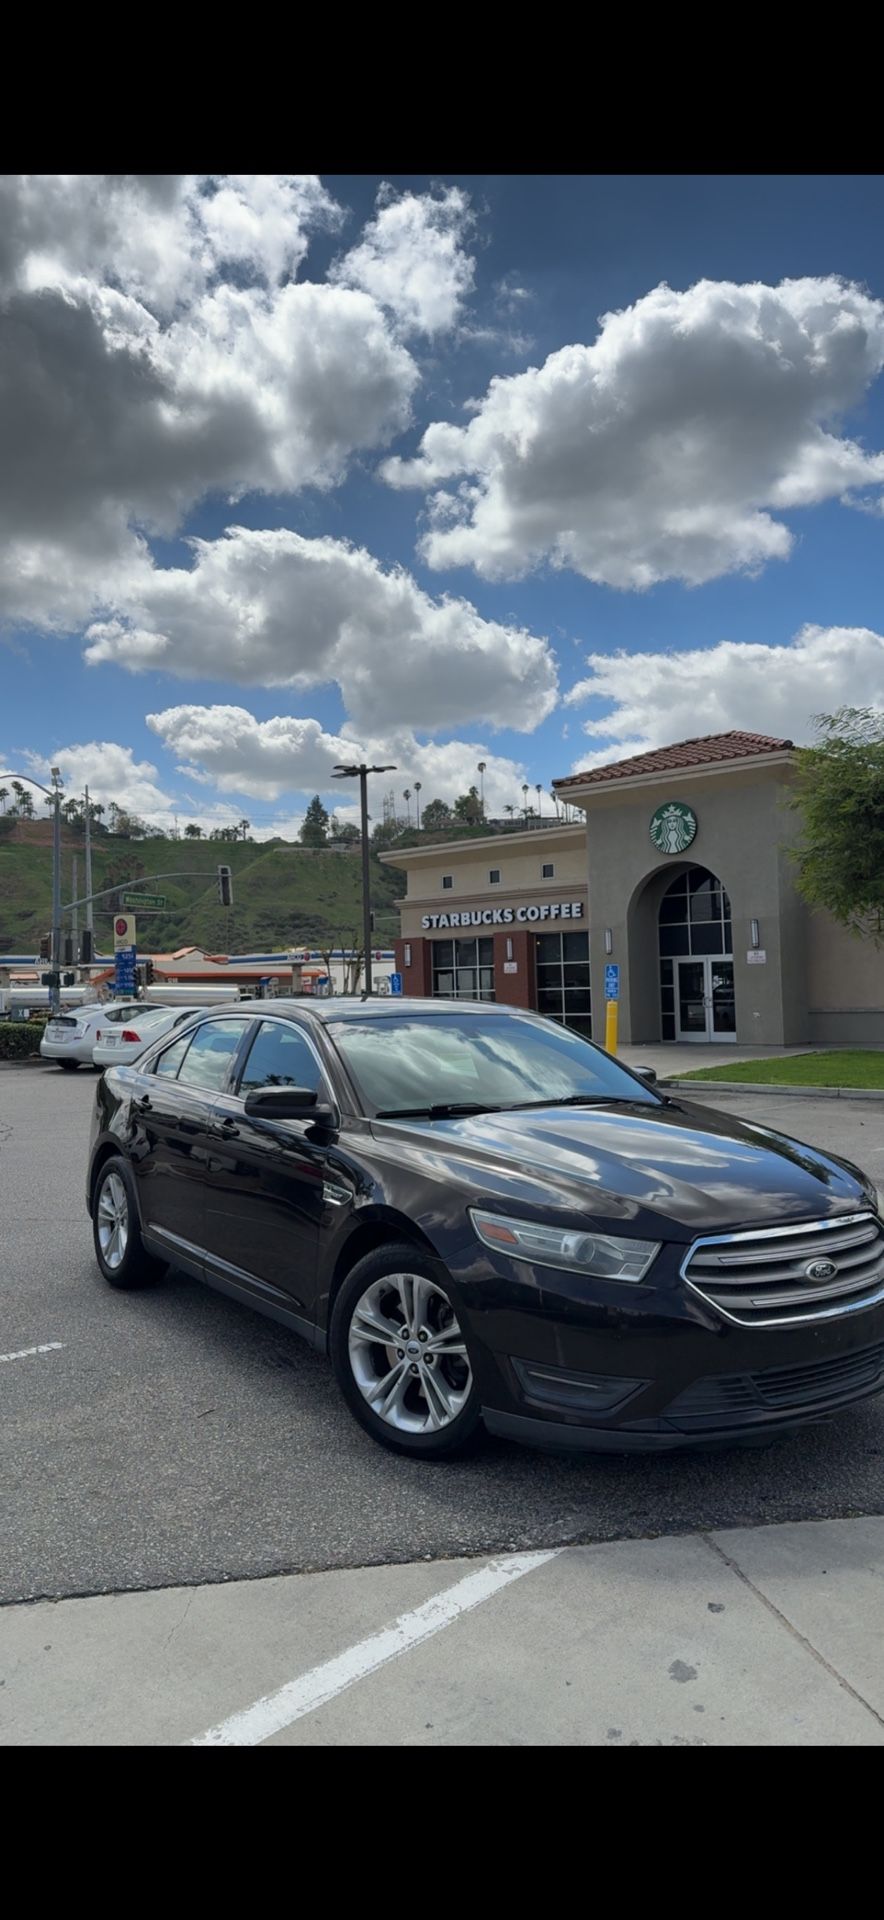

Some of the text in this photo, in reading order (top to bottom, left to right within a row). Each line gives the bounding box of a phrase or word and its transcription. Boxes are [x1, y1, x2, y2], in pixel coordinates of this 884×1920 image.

[421, 902, 582, 929] STARBUCKS COFFEE
[815, 1264, 832, 1277] Ford
